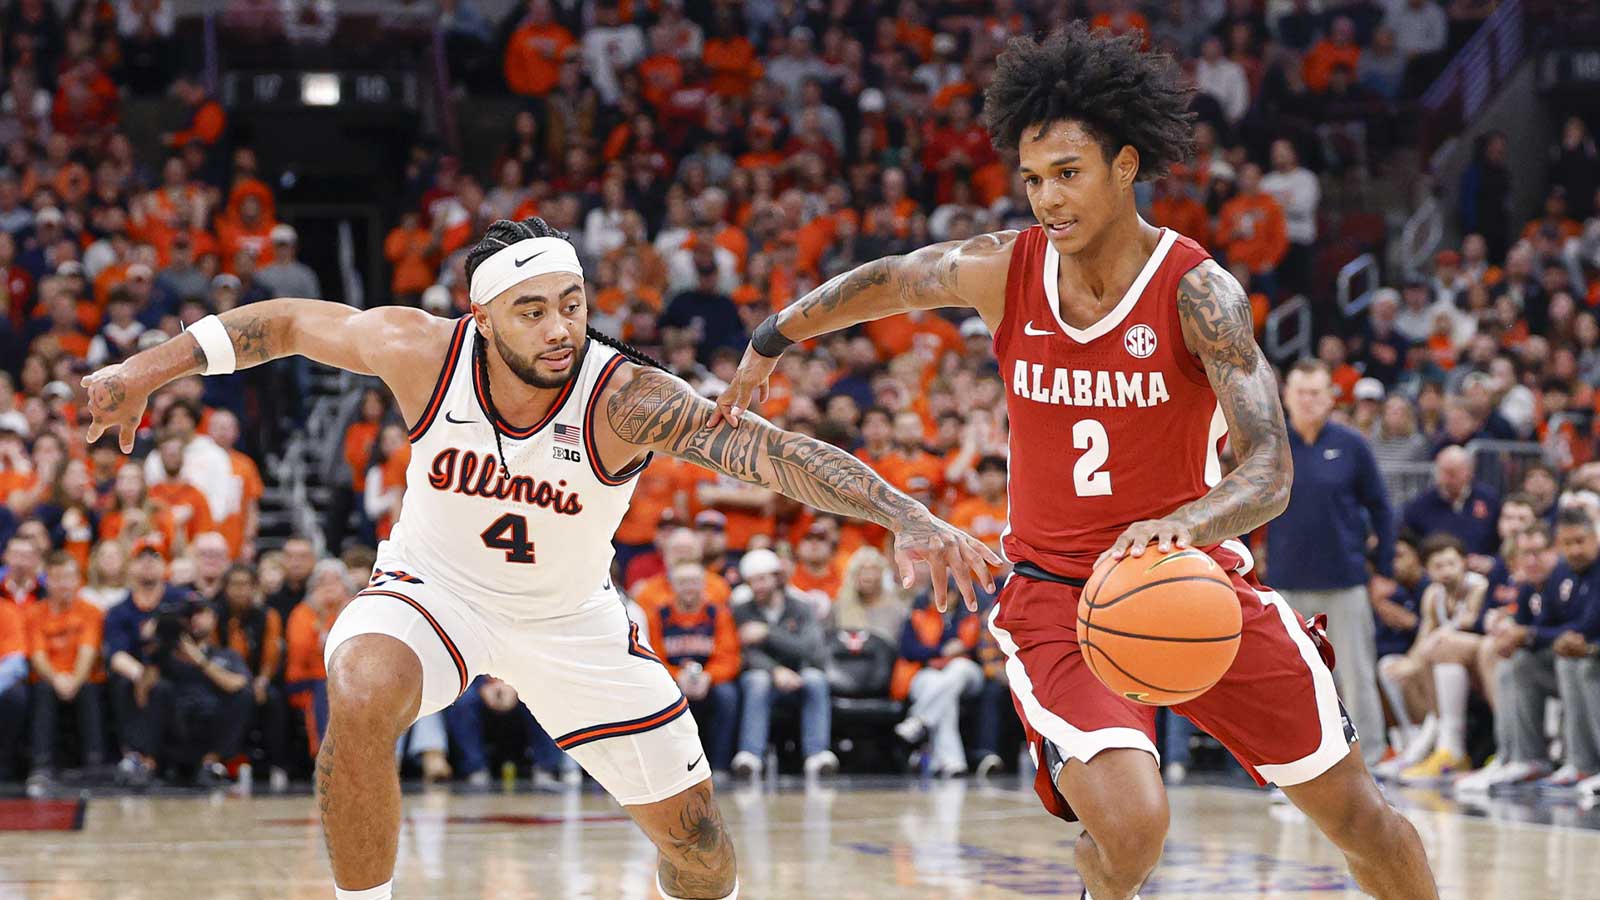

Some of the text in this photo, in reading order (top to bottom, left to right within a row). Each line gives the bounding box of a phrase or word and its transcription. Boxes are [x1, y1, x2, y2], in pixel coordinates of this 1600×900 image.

[1126, 325, 1155, 357] SEC
[1013, 359, 1170, 408] ALABAMA
[428, 447, 583, 516] Illinois
[1072, 418, 1113, 497] 2
[480, 512, 536, 564] 4
